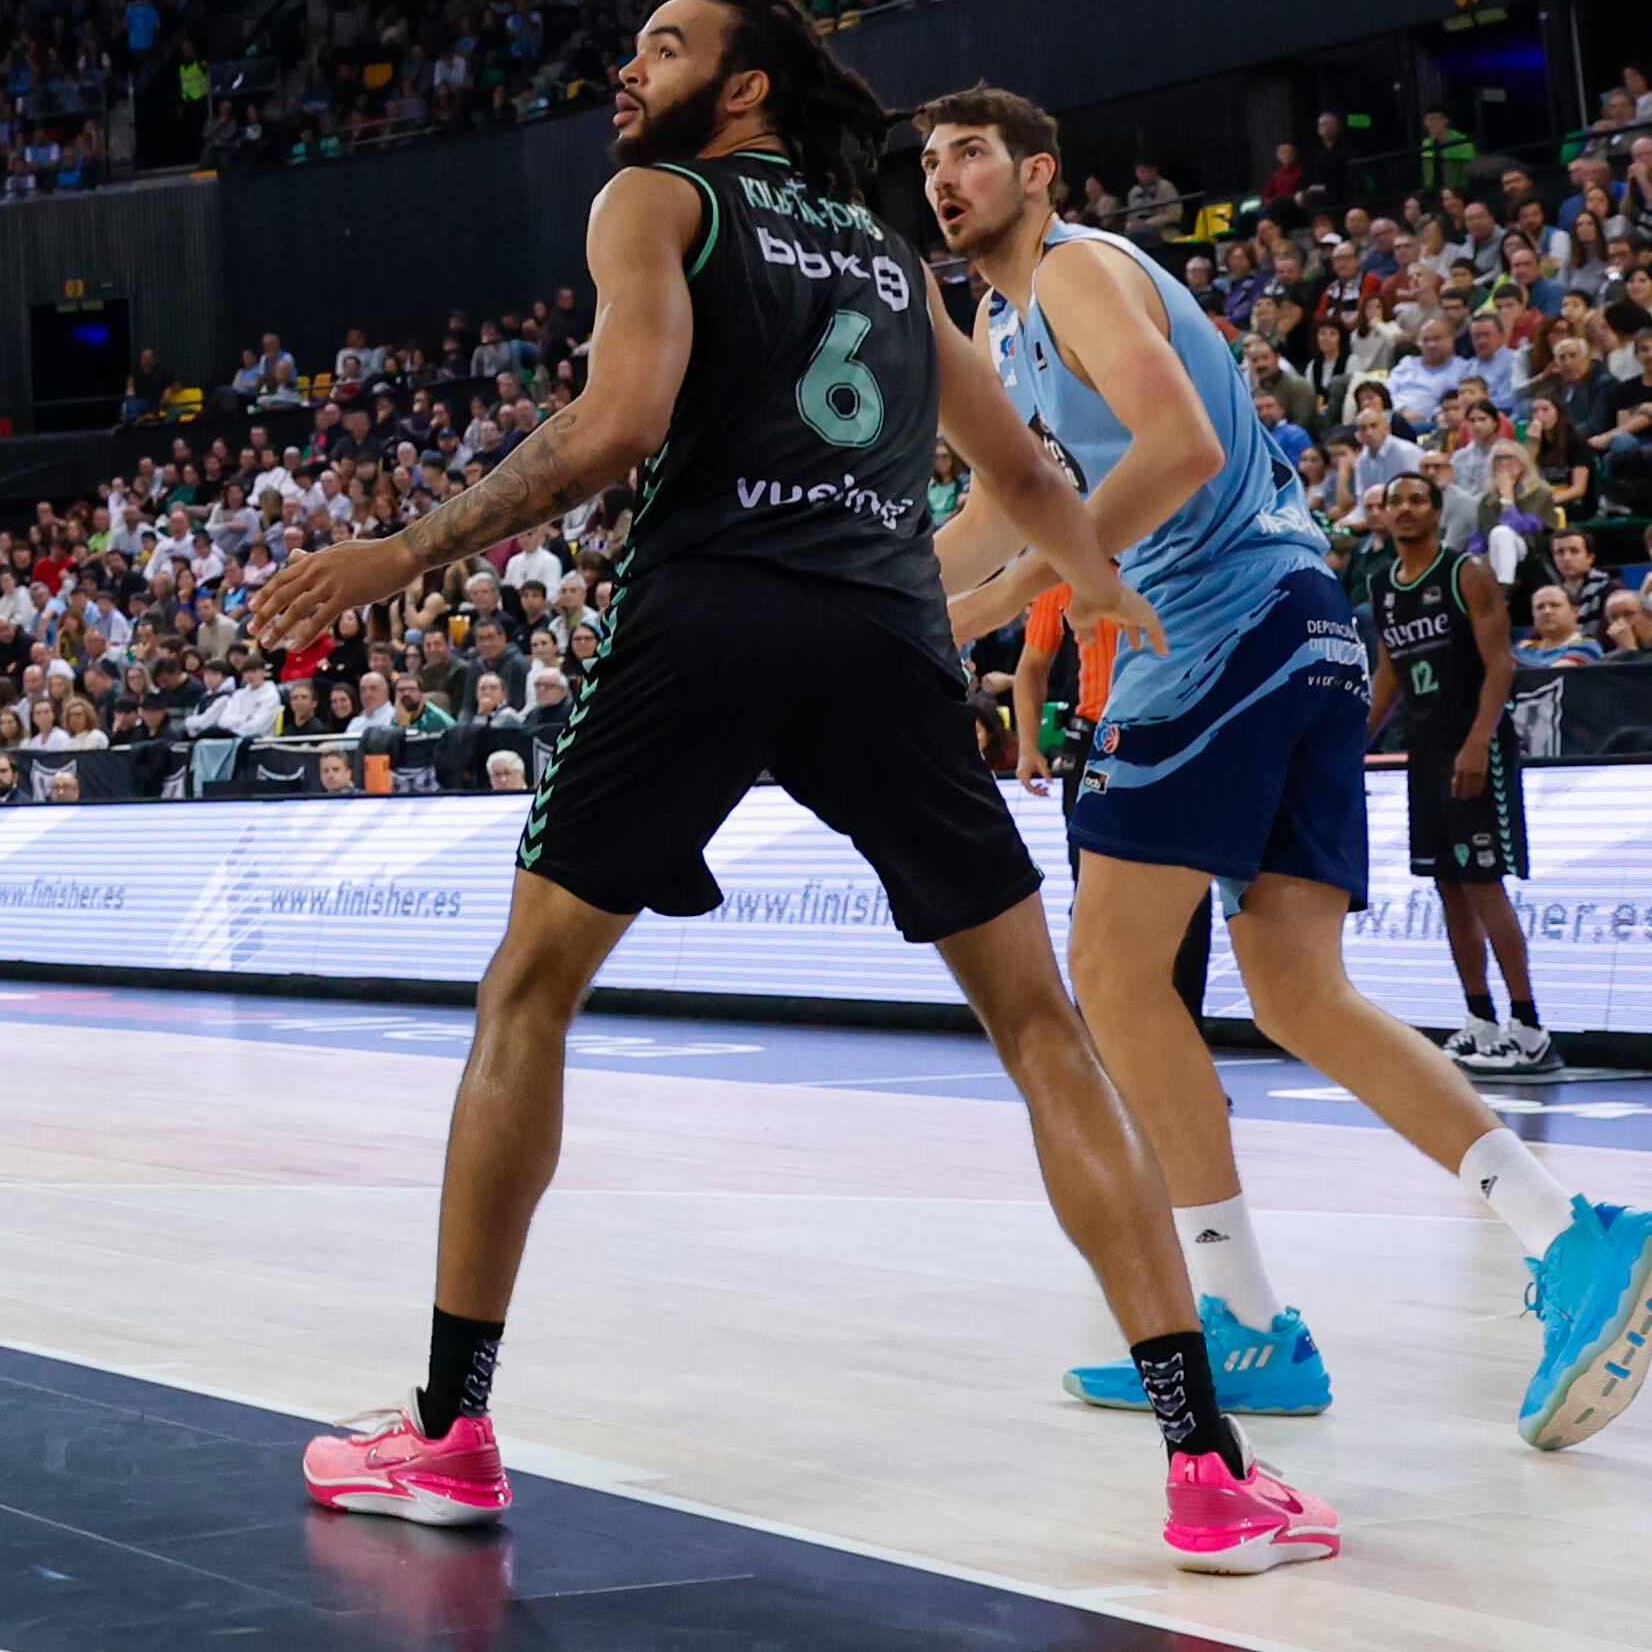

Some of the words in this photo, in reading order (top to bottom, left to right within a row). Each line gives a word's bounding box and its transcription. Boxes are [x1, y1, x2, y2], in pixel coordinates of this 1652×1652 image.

[795, 308, 886, 449] 6
[1383, 613, 1449, 648] surne
[1411, 660, 1440, 695] 12
[270, 877, 462, 918] www.finisher.es
